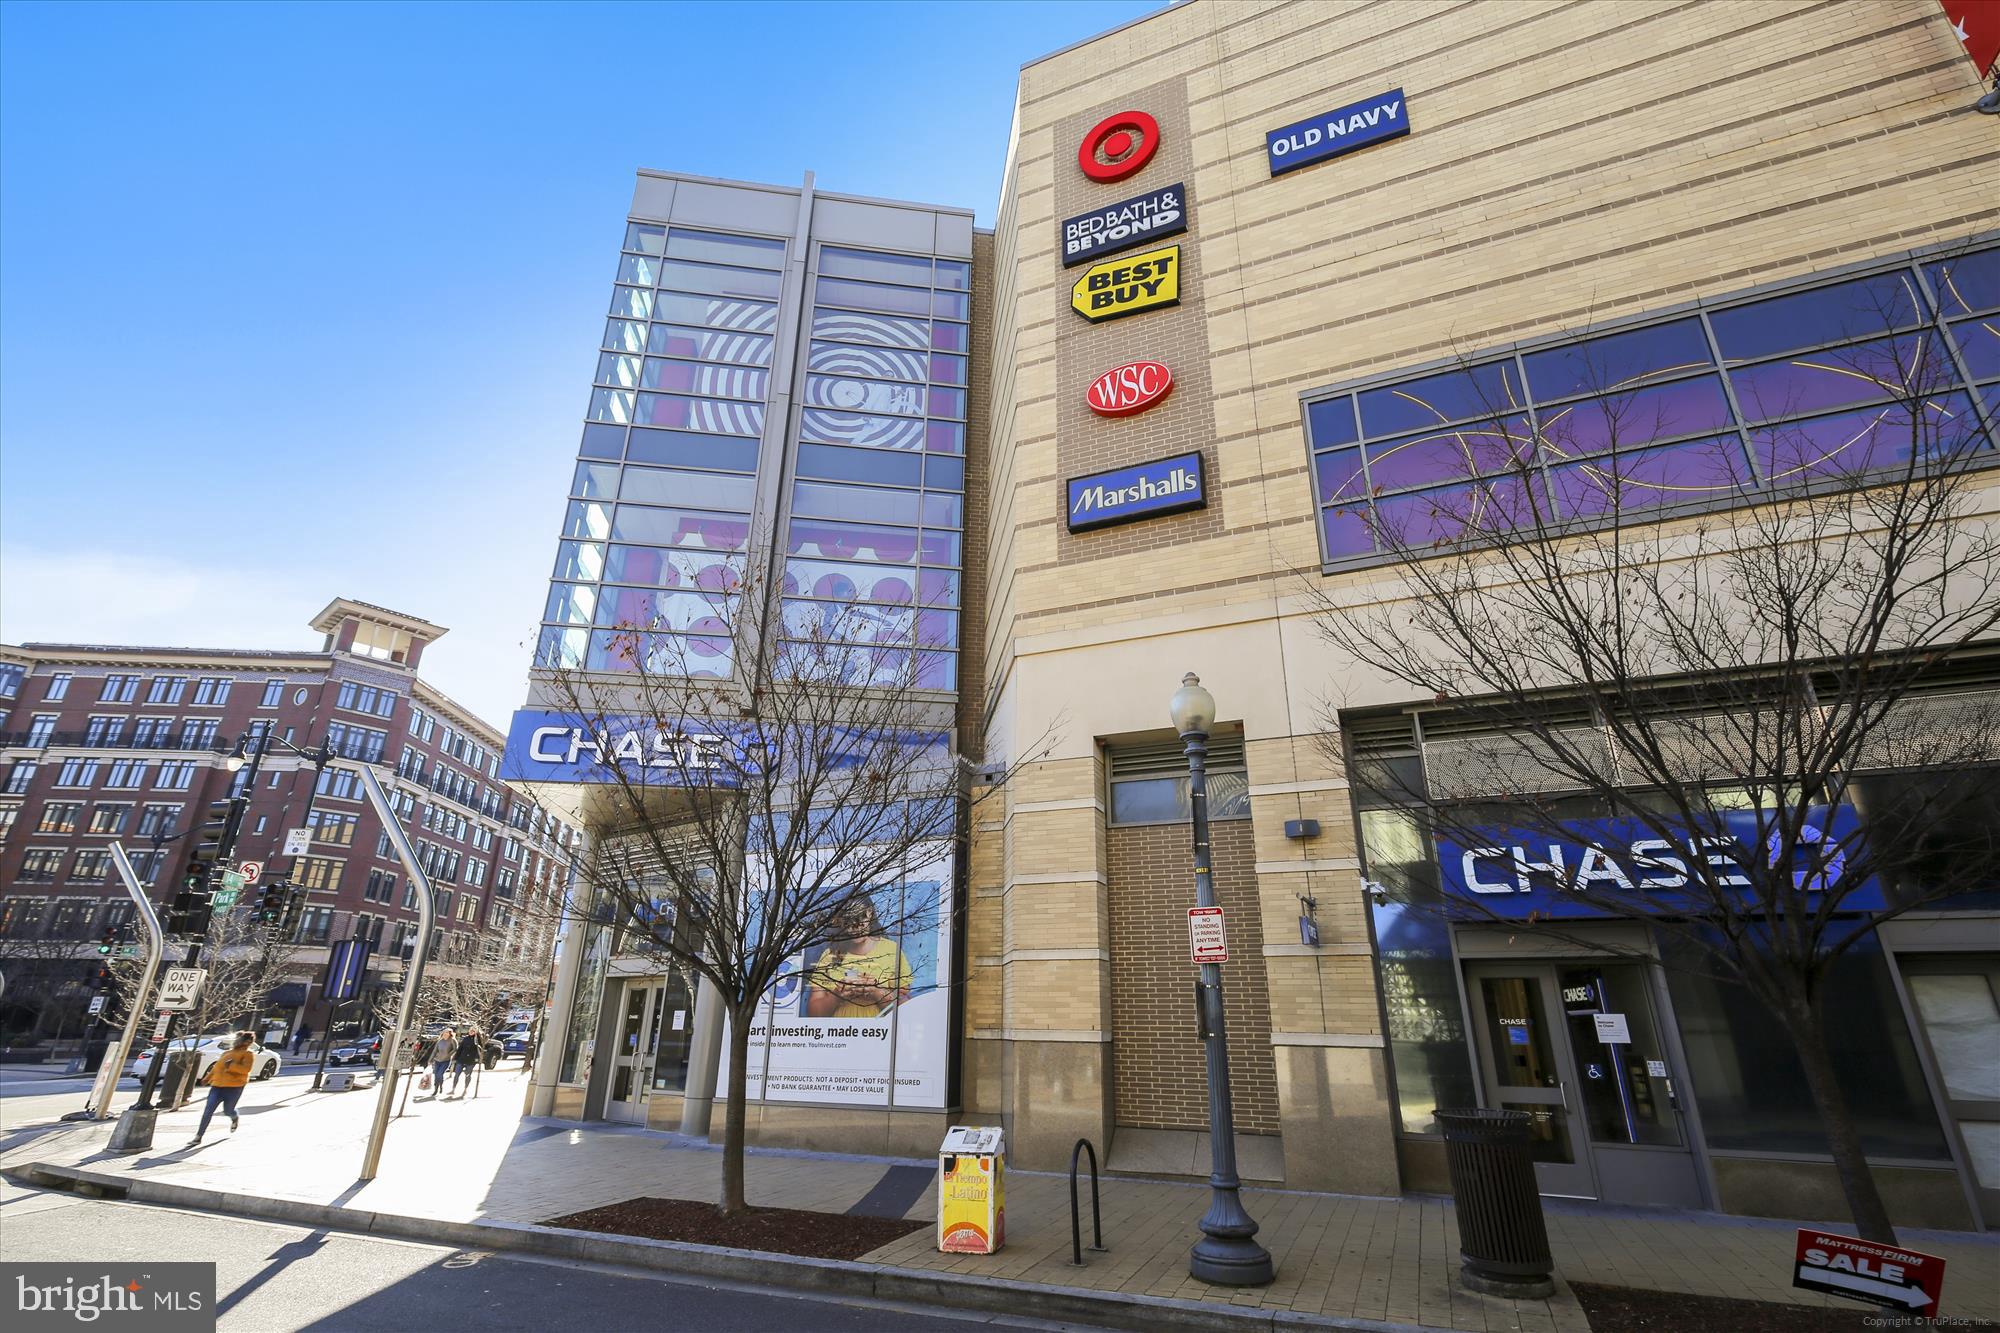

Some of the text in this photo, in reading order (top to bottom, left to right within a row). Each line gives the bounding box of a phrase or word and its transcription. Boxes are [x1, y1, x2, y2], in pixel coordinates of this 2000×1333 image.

[1272, 101, 1400, 156] OLD NAVY
[1067, 192, 1179, 241] BED BATH &
[1067, 210, 1180, 255] BEYOND
[1088, 256, 1174, 292] BEST
[1091, 277, 1165, 310] BUY
[1094, 365, 1159, 407] WSC
[1072, 468, 1197, 514] Marshalls
[529, 726, 726, 769] CHASE
[1462, 835, 1753, 894] CHASE
[214, 892, 230, 904] Park
[167, 984, 194, 992] WAY
[170, 972, 196, 982] ONE
[1563, 986, 1588, 1002] CHASE
[772, 1026, 824, 1040] investing,
[827, 1026, 859, 1037] made
[862, 1027, 888, 1040] easy
[952, 1185, 988, 1199] Latino
[955, 1173, 988, 1184] Tiempo
[1804, 1248, 1905, 1283] SALE
